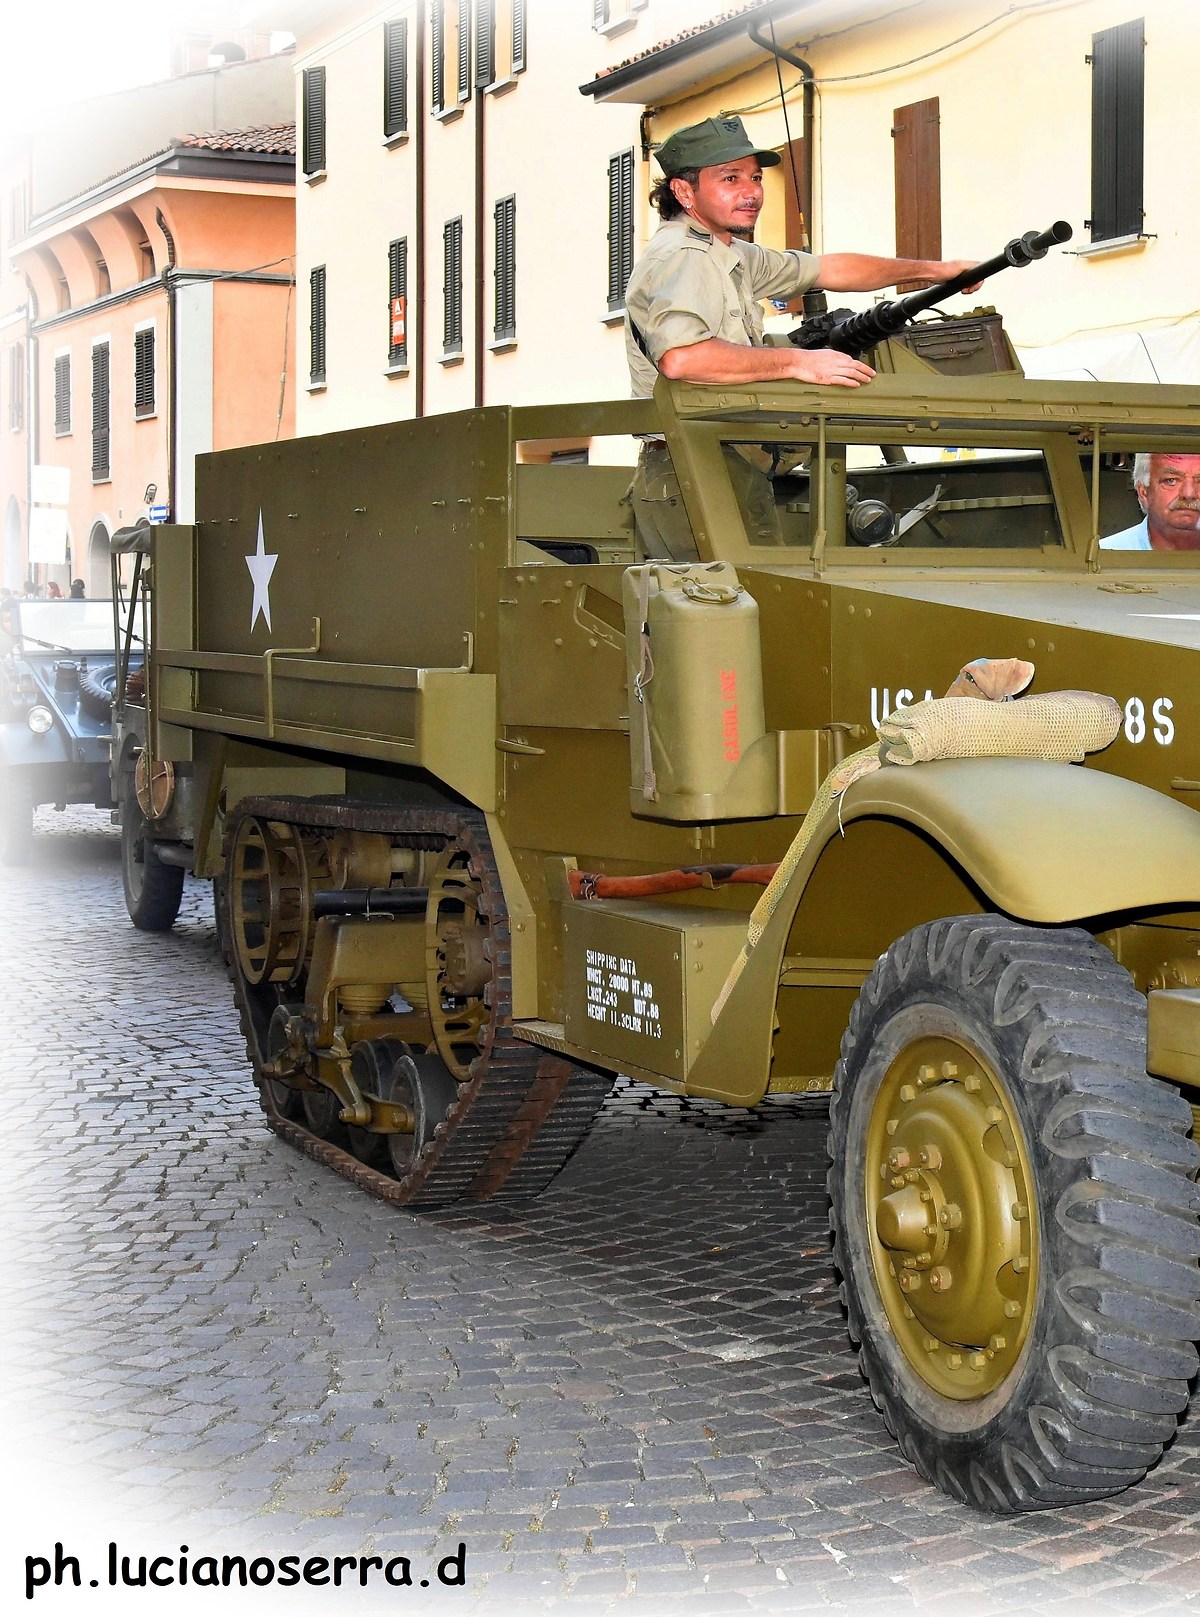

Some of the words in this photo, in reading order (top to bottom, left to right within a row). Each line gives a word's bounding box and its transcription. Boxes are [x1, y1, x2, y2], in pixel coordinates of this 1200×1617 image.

[720, 667, 740, 762] GASOLINE
[586, 949, 617, 971] SHIPPING
[620, 957, 637, 976] DATA
[608, 973, 629, 993] 20000
